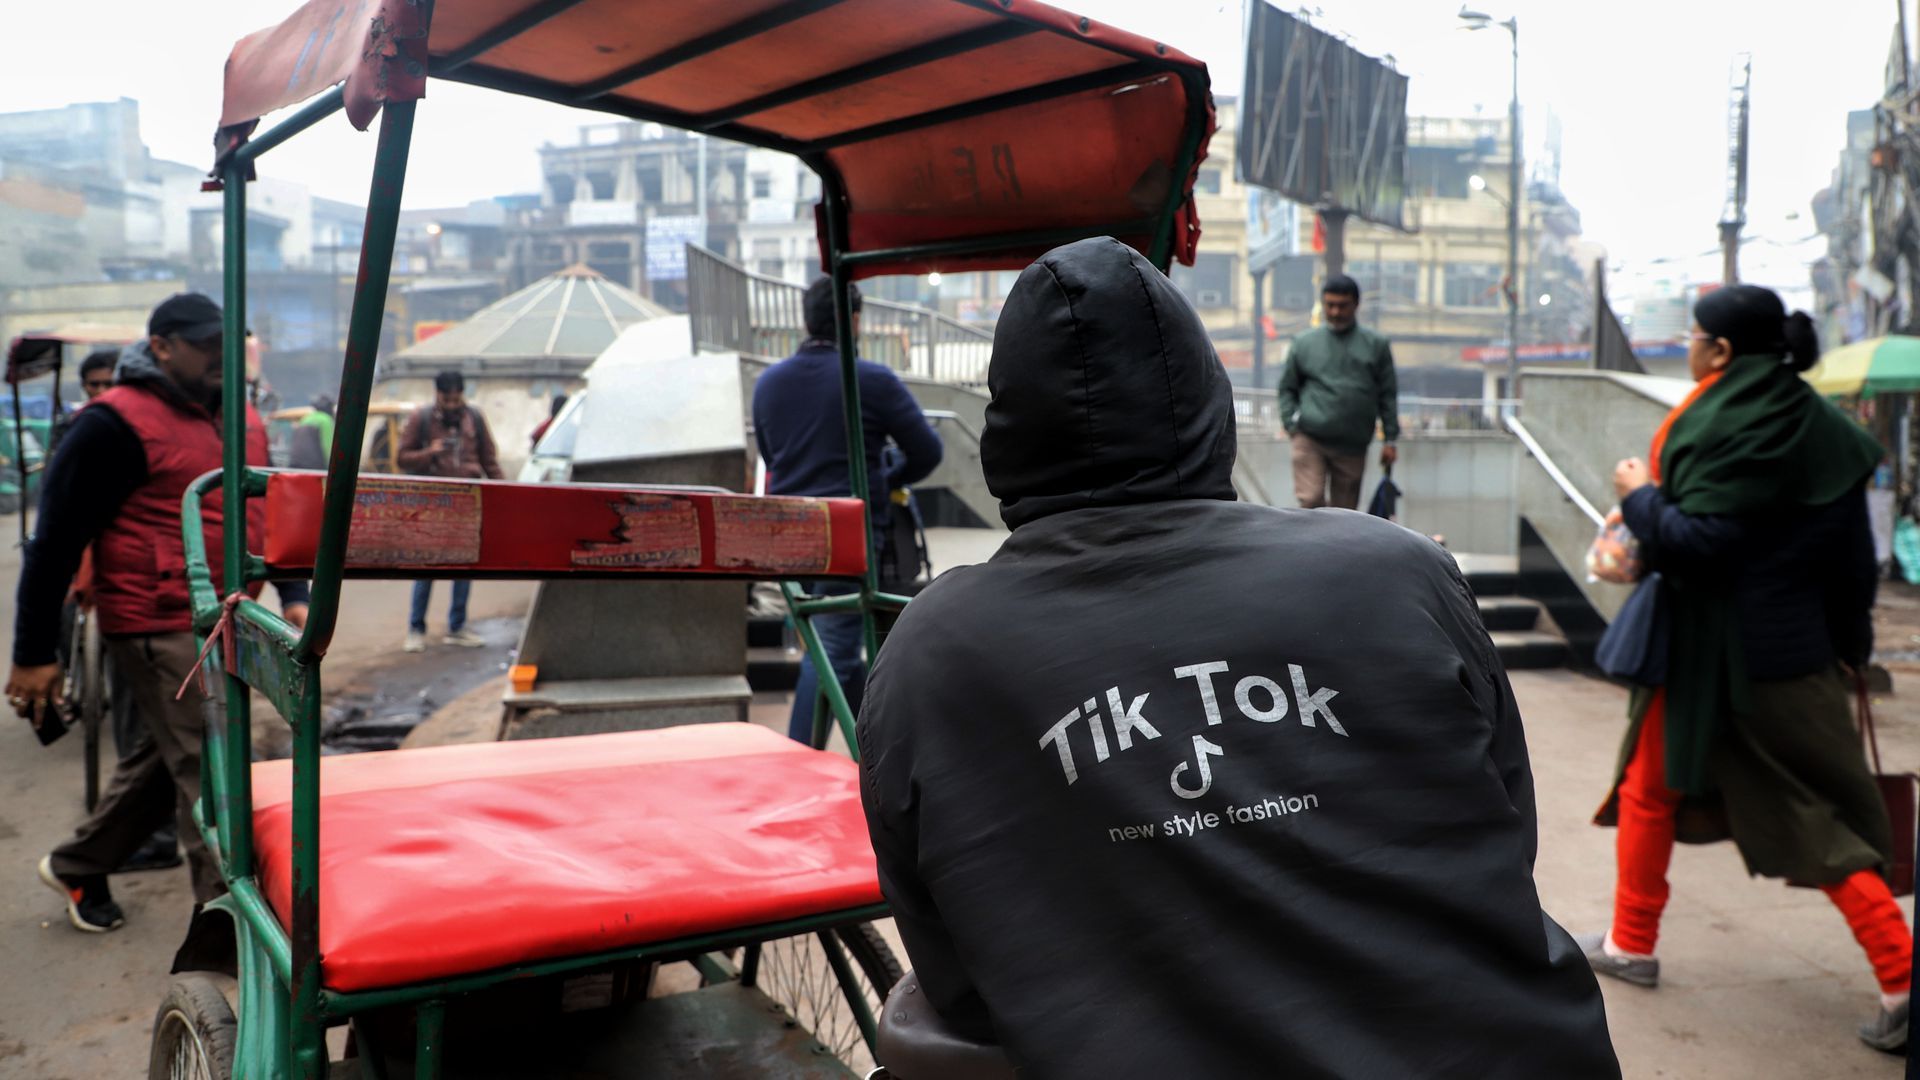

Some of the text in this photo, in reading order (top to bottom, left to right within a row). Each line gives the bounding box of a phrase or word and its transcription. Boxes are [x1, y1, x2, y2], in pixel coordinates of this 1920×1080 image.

[1039, 661, 1349, 785] Tik Tok
[1109, 792, 1319, 842] new style fashion
